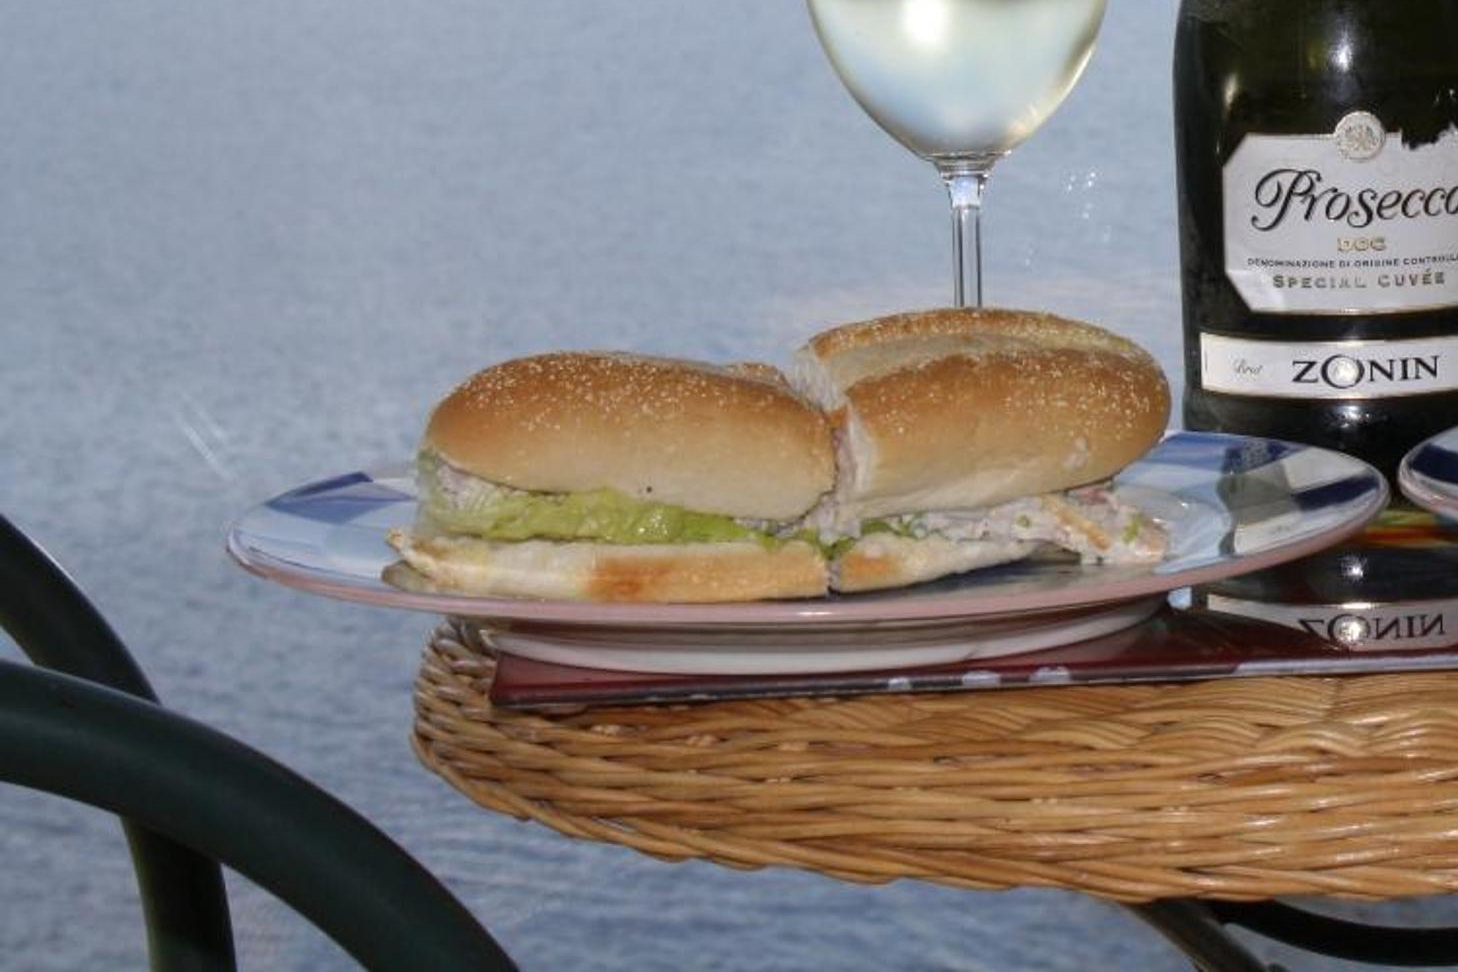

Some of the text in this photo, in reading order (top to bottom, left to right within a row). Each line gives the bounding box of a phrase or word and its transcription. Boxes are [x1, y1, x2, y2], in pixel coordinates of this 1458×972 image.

[1272, 268, 1445, 289] SPECIAL CUVÉE
[1292, 354, 1440, 389] ZONIN
